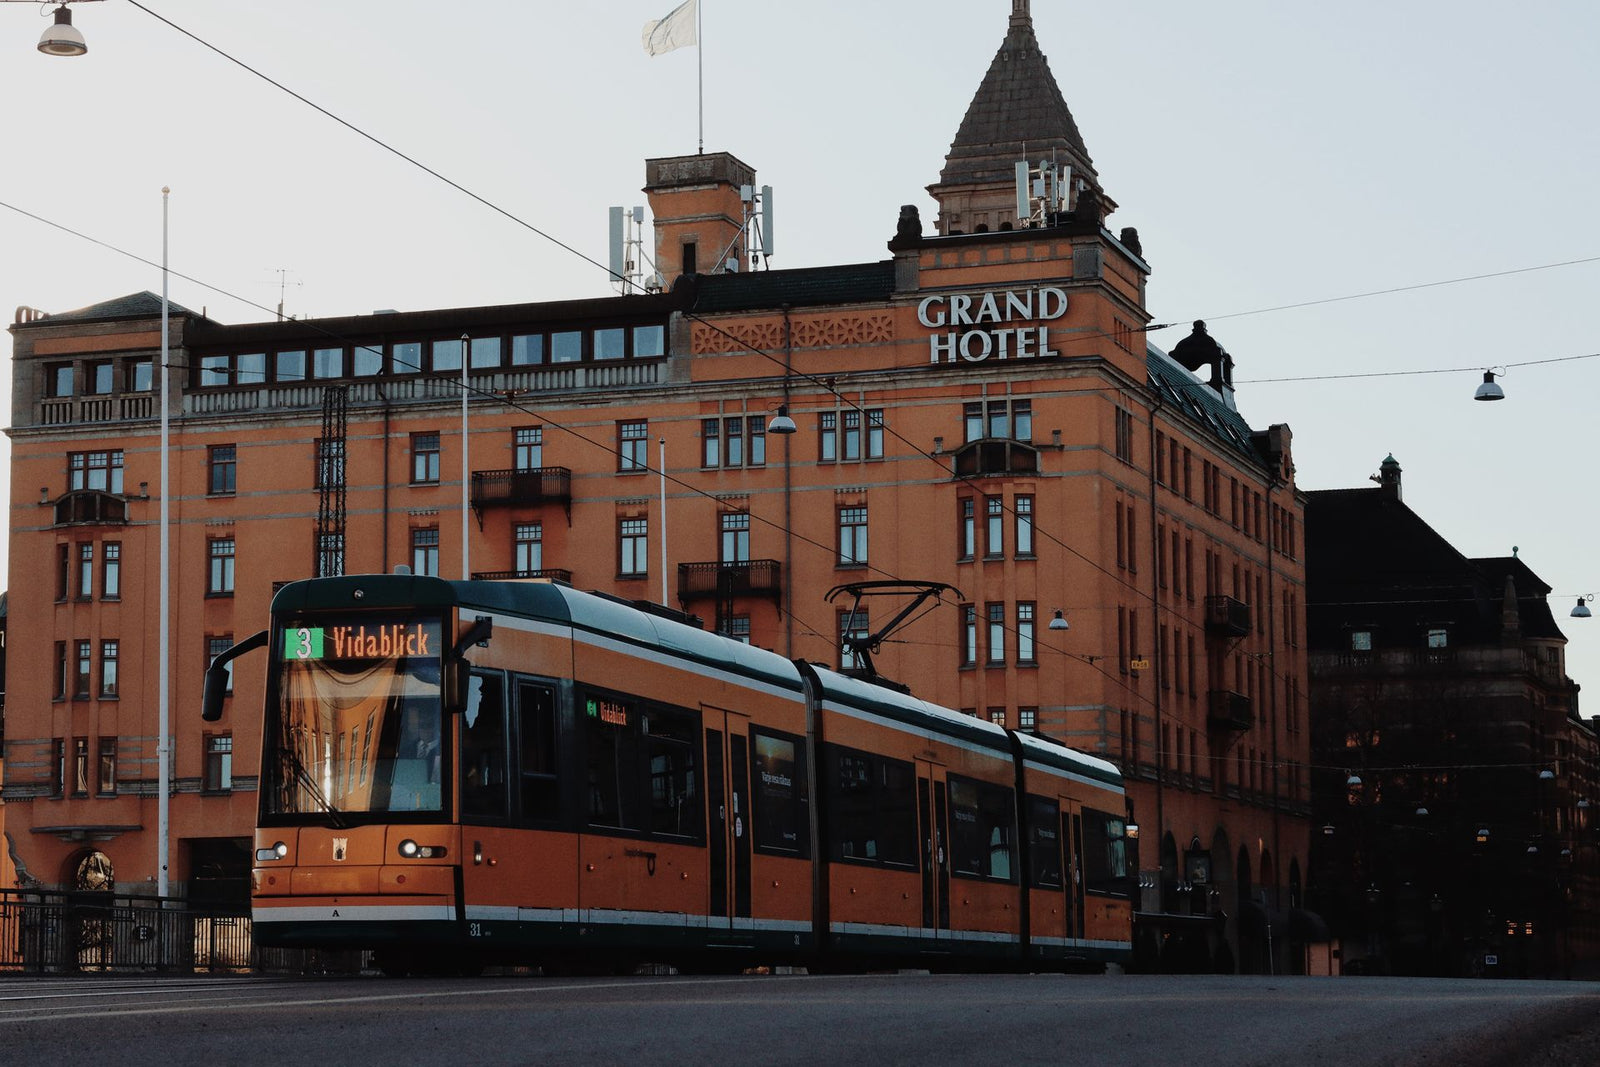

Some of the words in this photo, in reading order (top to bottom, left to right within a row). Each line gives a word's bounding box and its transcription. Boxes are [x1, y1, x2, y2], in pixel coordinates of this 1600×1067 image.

[917, 287, 1068, 328] GRAND
[930, 326, 1058, 364] HOTEL
[296, 628, 312, 658] 3
[333, 624, 428, 657] Vidablick
[332, 909, 340, 917] A
[469, 922, 482, 937] 31
